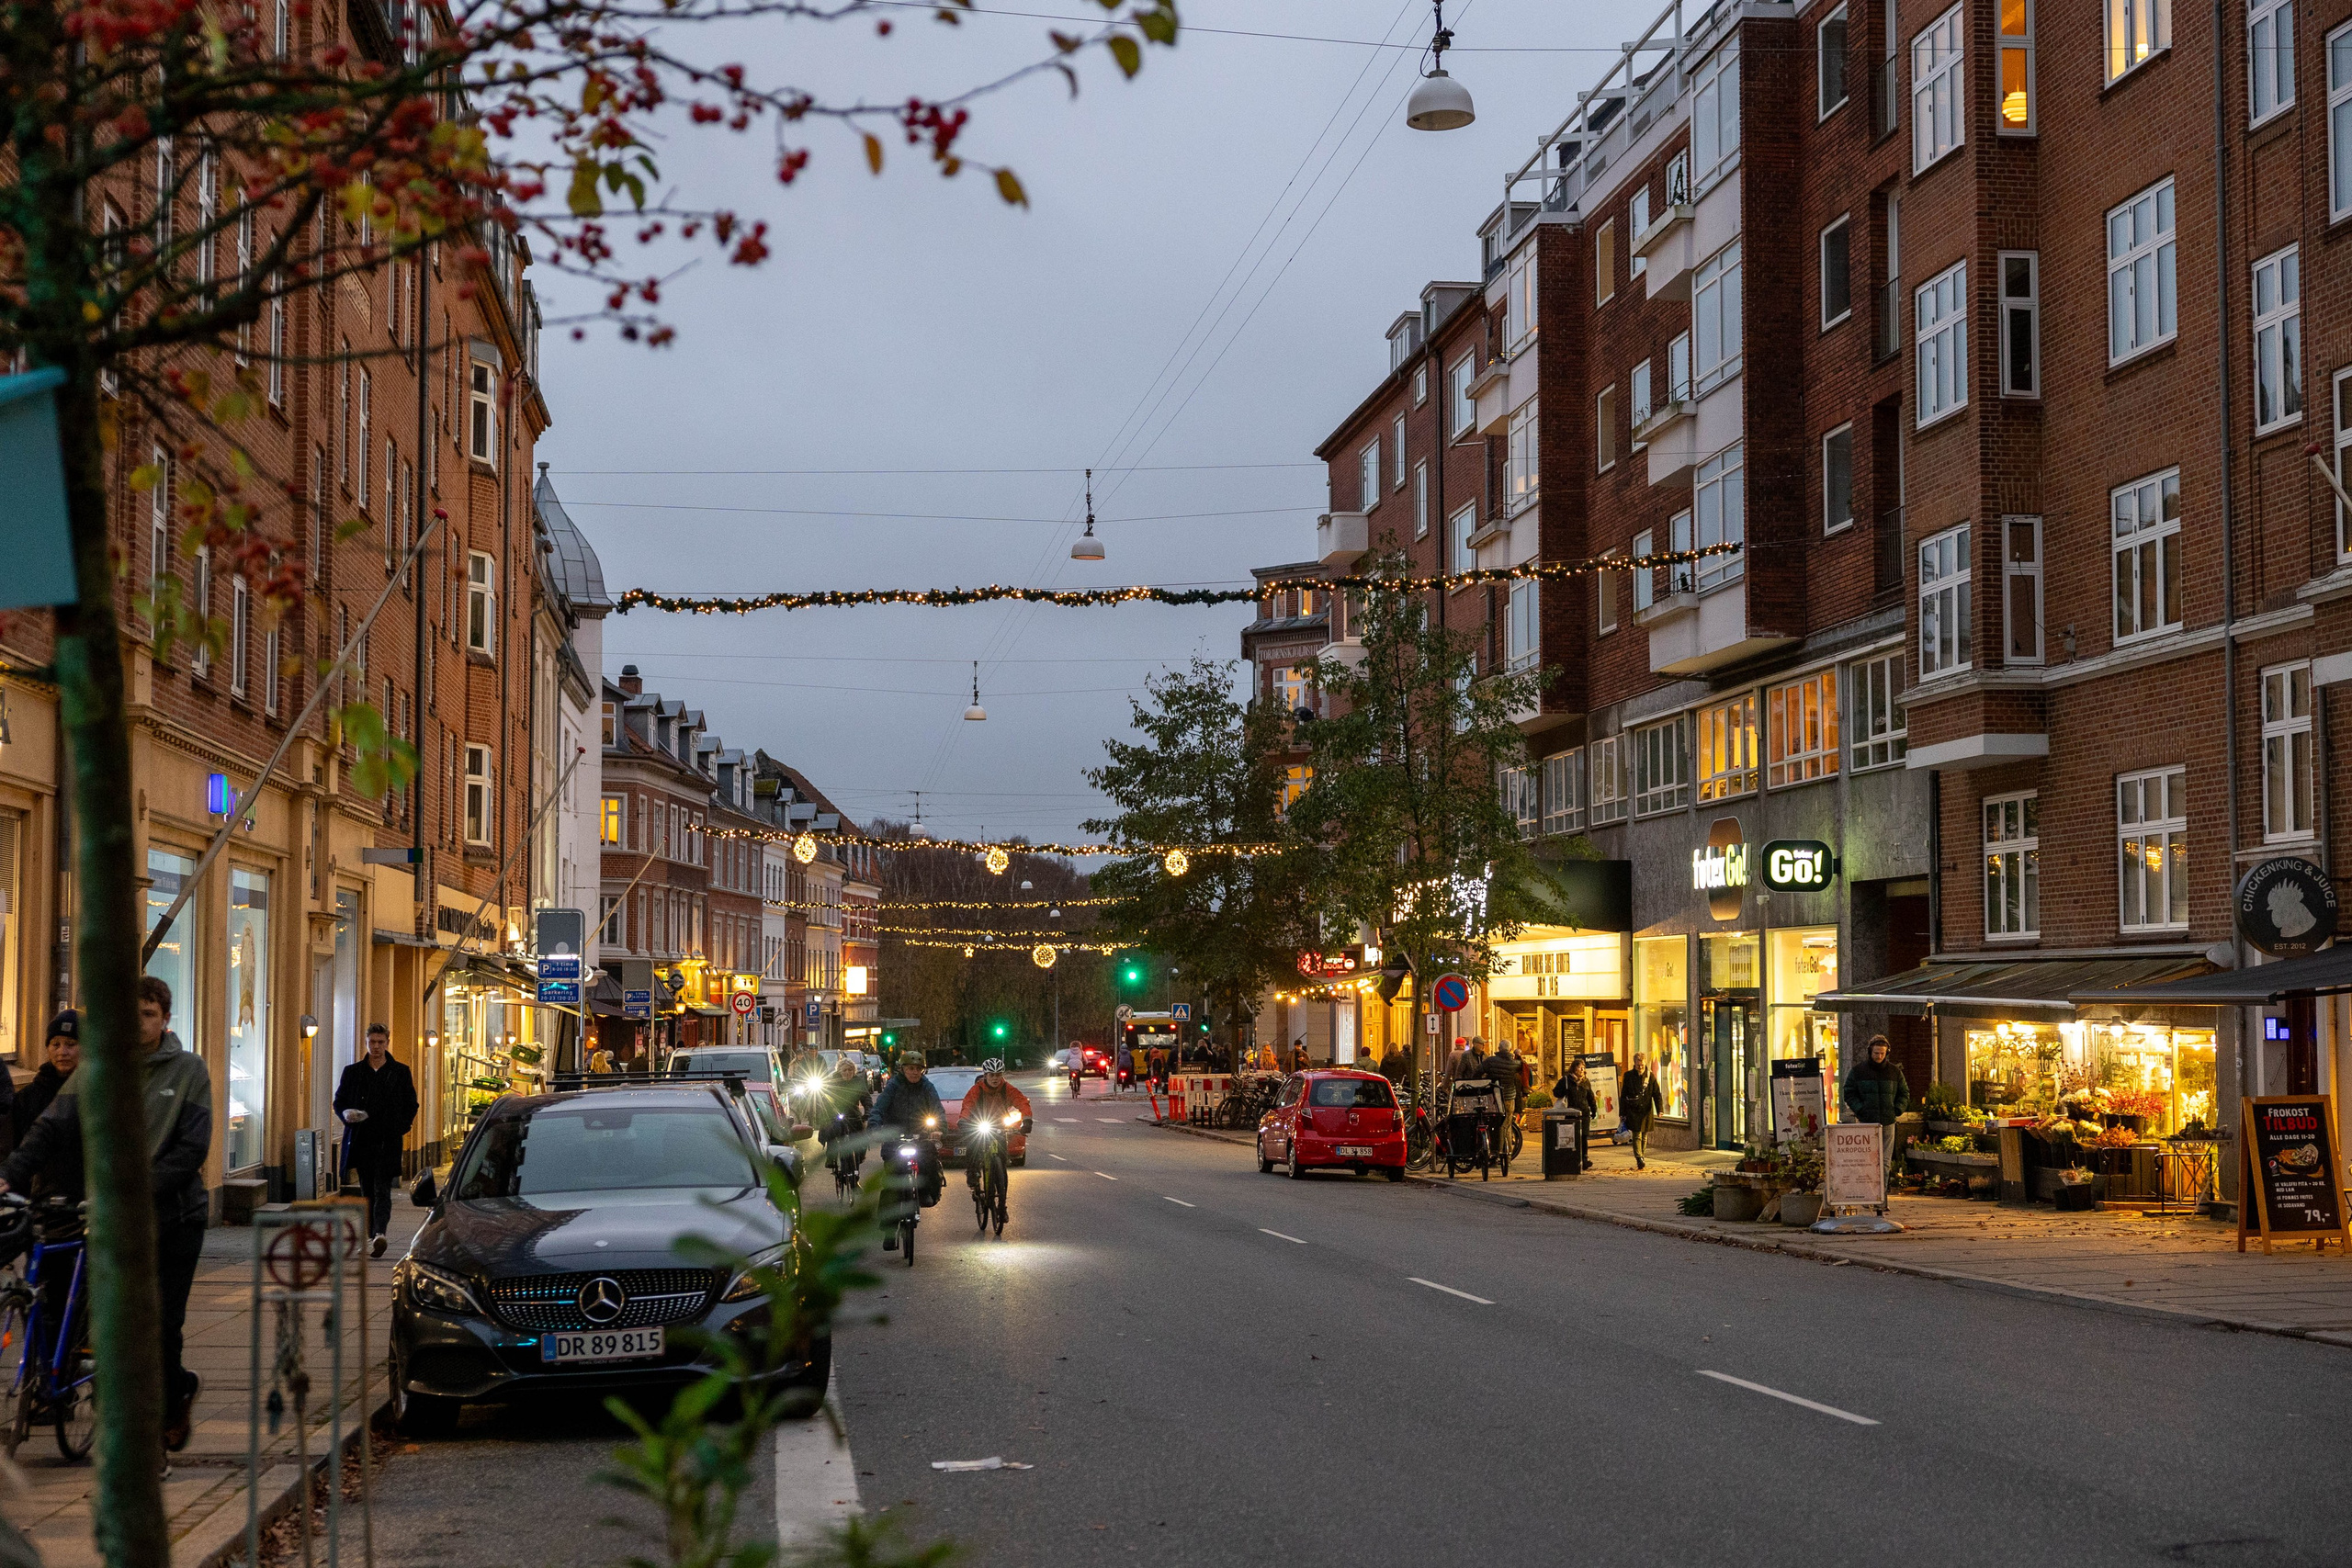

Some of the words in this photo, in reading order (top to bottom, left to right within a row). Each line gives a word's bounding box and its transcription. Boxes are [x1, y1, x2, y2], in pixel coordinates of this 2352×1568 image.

[1770, 849, 1824, 884] Go!
[2304, 865, 2313, 876] &
[2313, 874, 2336, 908] JUICE
[736, 998, 751, 1008] 40
[809, 1004, 818, 1016] P
[2267, 1108, 2310, 1118] FROKOST
[2263, 1115, 2318, 1131] TILBUD
[1837, 1134, 1871, 1145] DØGN
[2304, 1209, 2331, 1224] 79,-
[558, 1337, 585, 1357] DR
[591, 1335, 616, 1356] 89
[622, 1332, 661, 1354] 815
